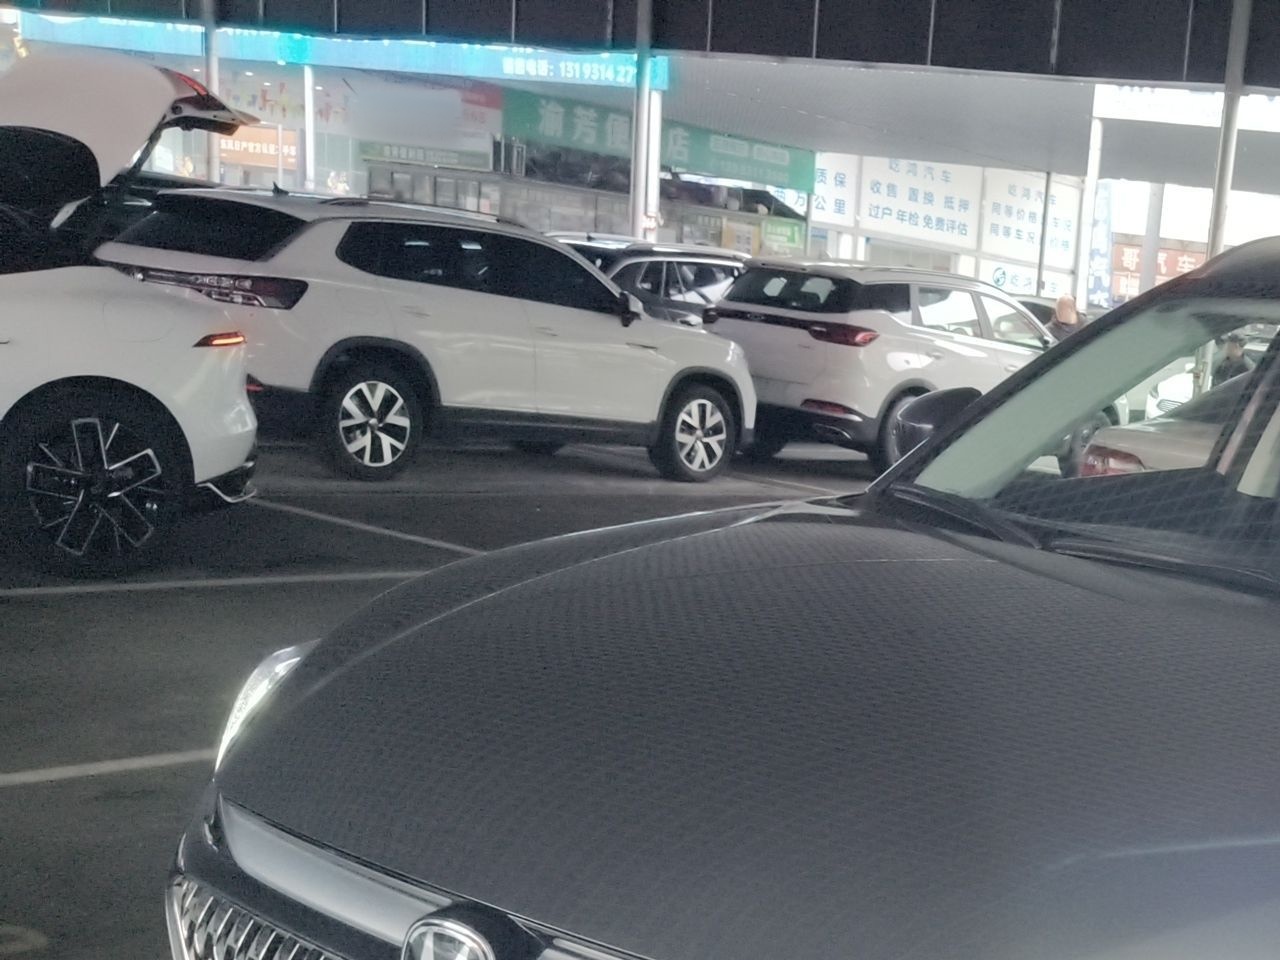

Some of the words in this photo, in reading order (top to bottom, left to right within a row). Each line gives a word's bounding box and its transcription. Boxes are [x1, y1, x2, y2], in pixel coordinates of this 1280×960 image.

[868, 203, 893, 220] 过户
[896, 208, 920, 227] 年检
[922, 213, 969, 237] 免费评估
